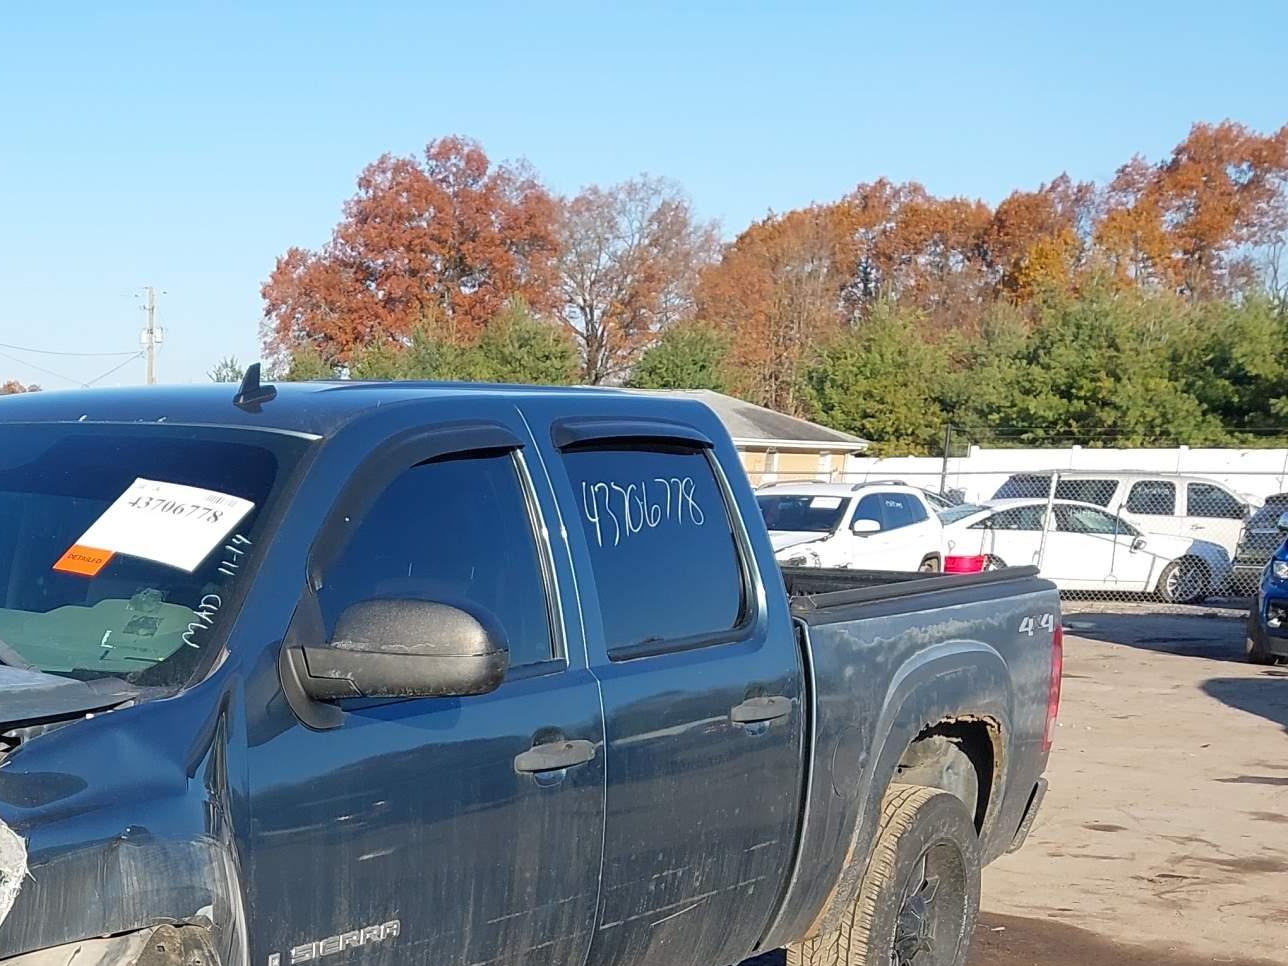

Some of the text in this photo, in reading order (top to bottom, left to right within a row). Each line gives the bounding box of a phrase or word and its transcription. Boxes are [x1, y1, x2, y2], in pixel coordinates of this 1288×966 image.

[128, 495, 224, 524] 43706778
[582, 477, 705, 548] 43706778
[181, 534, 253, 649] MAD 11-14
[291, 919, 401, 965] SIERRA
